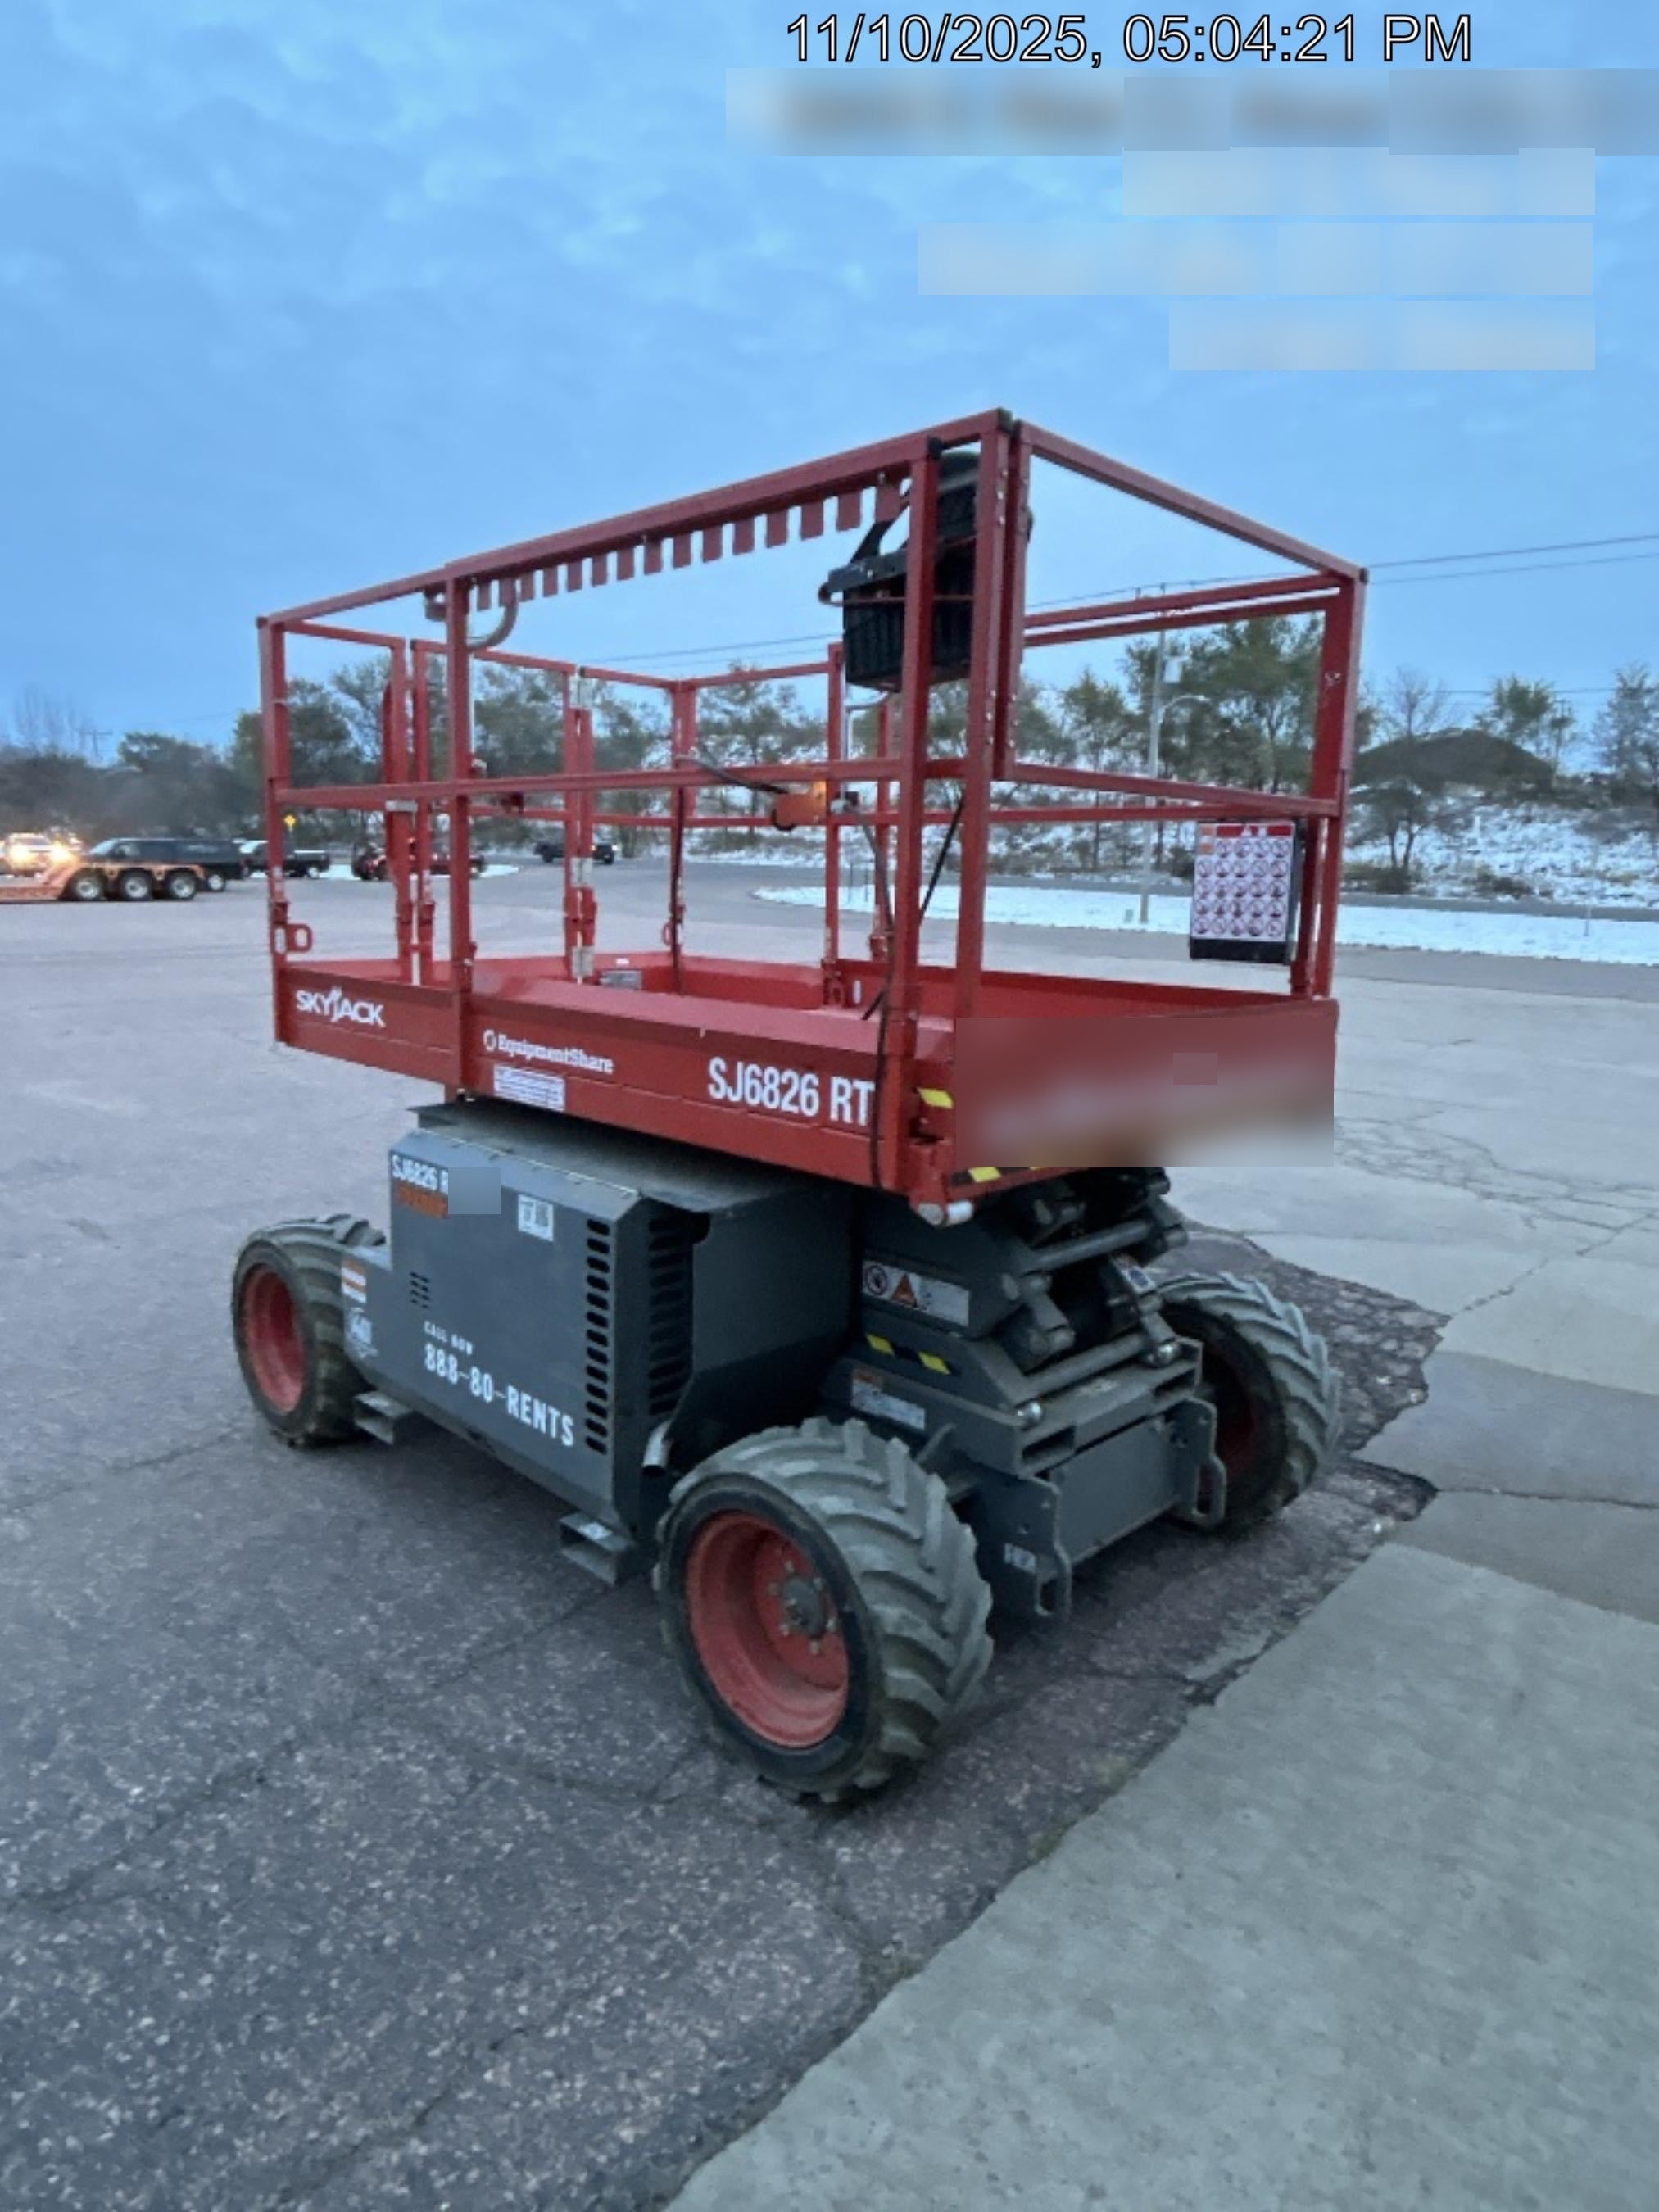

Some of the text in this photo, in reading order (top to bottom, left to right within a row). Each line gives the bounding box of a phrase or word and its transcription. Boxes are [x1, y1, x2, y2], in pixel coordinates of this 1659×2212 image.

[296, 986, 385, 1027] SKYJACK
[707, 1056, 875, 1126] SJ6826 RT
[424, 1342, 574, 1447] 888-80-RENTS
